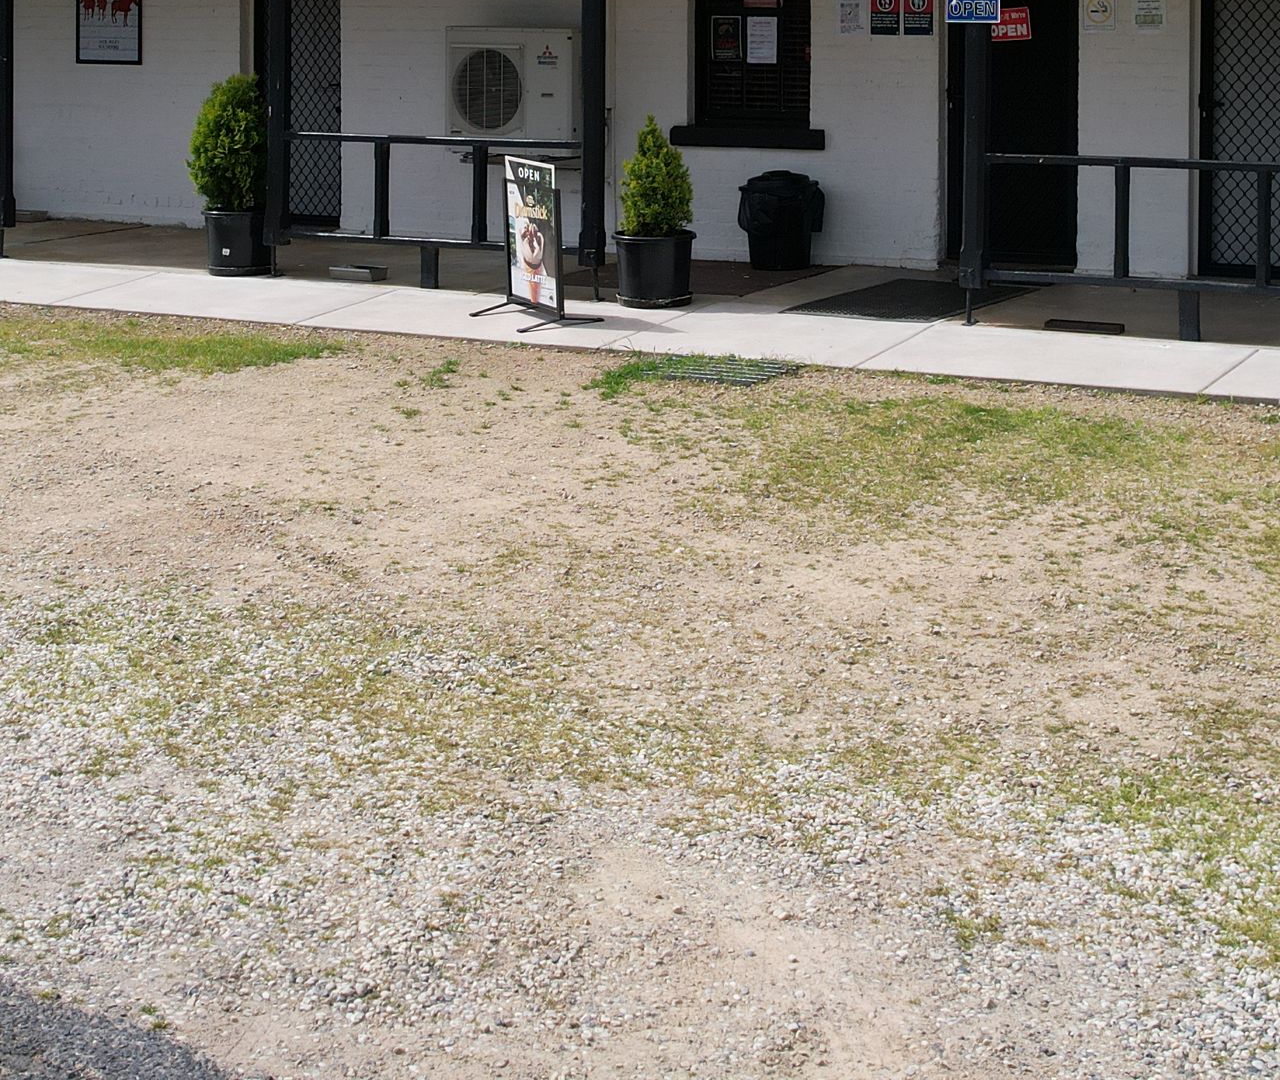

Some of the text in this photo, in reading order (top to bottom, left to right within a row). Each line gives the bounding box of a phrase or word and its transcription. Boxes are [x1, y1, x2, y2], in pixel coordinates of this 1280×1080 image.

[949, 0, 997, 17] OPEN
[991, 23, 1028, 37] OPEN
[518, 167, 540, 182] OPEN
